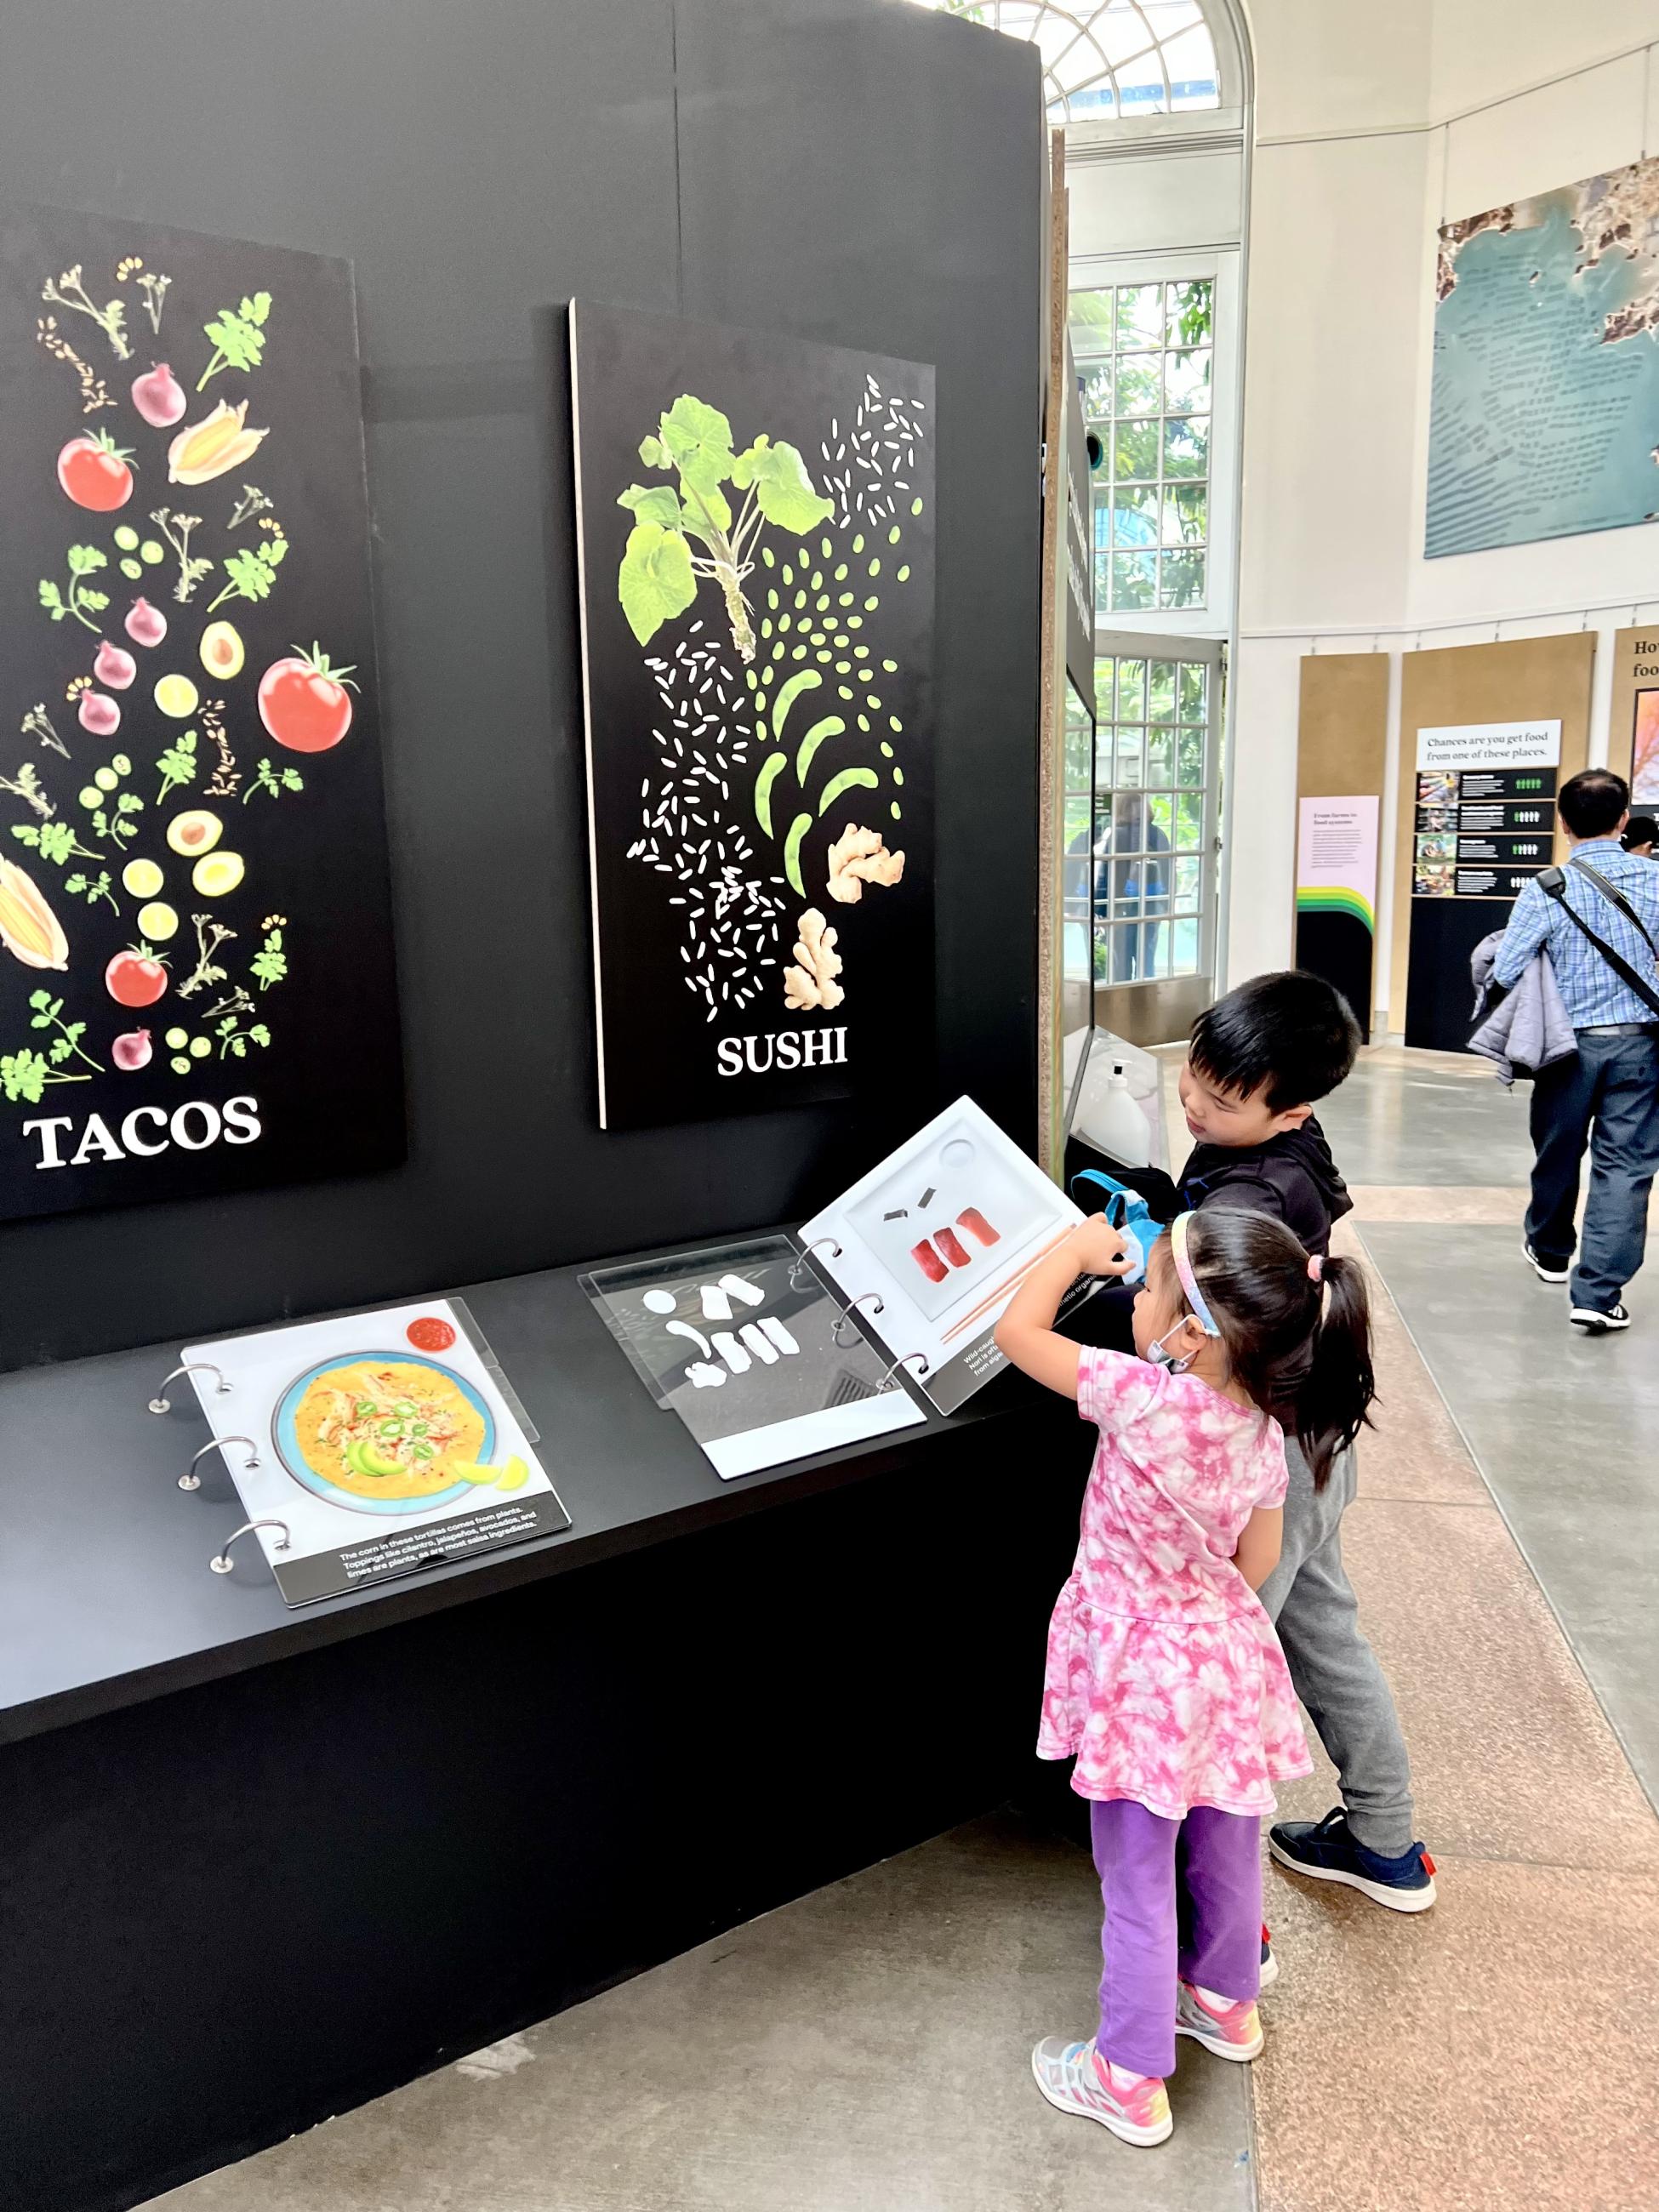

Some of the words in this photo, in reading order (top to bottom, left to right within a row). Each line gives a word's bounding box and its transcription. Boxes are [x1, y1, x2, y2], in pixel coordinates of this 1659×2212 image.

[1633, 641, 1659, 654] Ho
[1427, 751, 1451, 761] from
[1472, 750, 1482, 759] of
[1484, 749, 1510, 759] these
[1512, 747, 1548, 759] places.
[1428, 738, 1467, 747] Chances
[1468, 737, 1485, 745] are
[1486, 735, 1505, 746] you
[1507, 734, 1522, 745] get
[1525, 732, 1548, 742] food
[717, 1026, 848, 1076] SUSHI
[23, 1096, 262, 1170] TACOS
[968, 1356, 983, 1370] Nori
[974, 1362, 990, 1377] from
[339, 1552, 357, 1561] The
[358, 1546, 379, 1556] corn
[389, 1536, 413, 1548] these
[413, 1528, 446, 1541] tortillas
[447, 1519, 476, 1532] comes
[475, 1514, 496, 1524] from
[495, 1508, 523, 1520] plants.
[343, 1554, 385, 1570] Toppings
[385, 1548, 401, 1558] like
[479, 1517, 521, 1532] avocados,
[520, 1511, 537, 1521] and
[347, 1568, 372, 1579] limes
[373, 1563, 387, 1572] are
[388, 1554, 419, 1568] plants,
[419, 1550, 429, 1559] as
[430, 1547, 444, 1556] are
[445, 1539, 467, 1551] most
[467, 1534, 489, 1545] salsa
[488, 1522, 538, 1538] ingredients.
